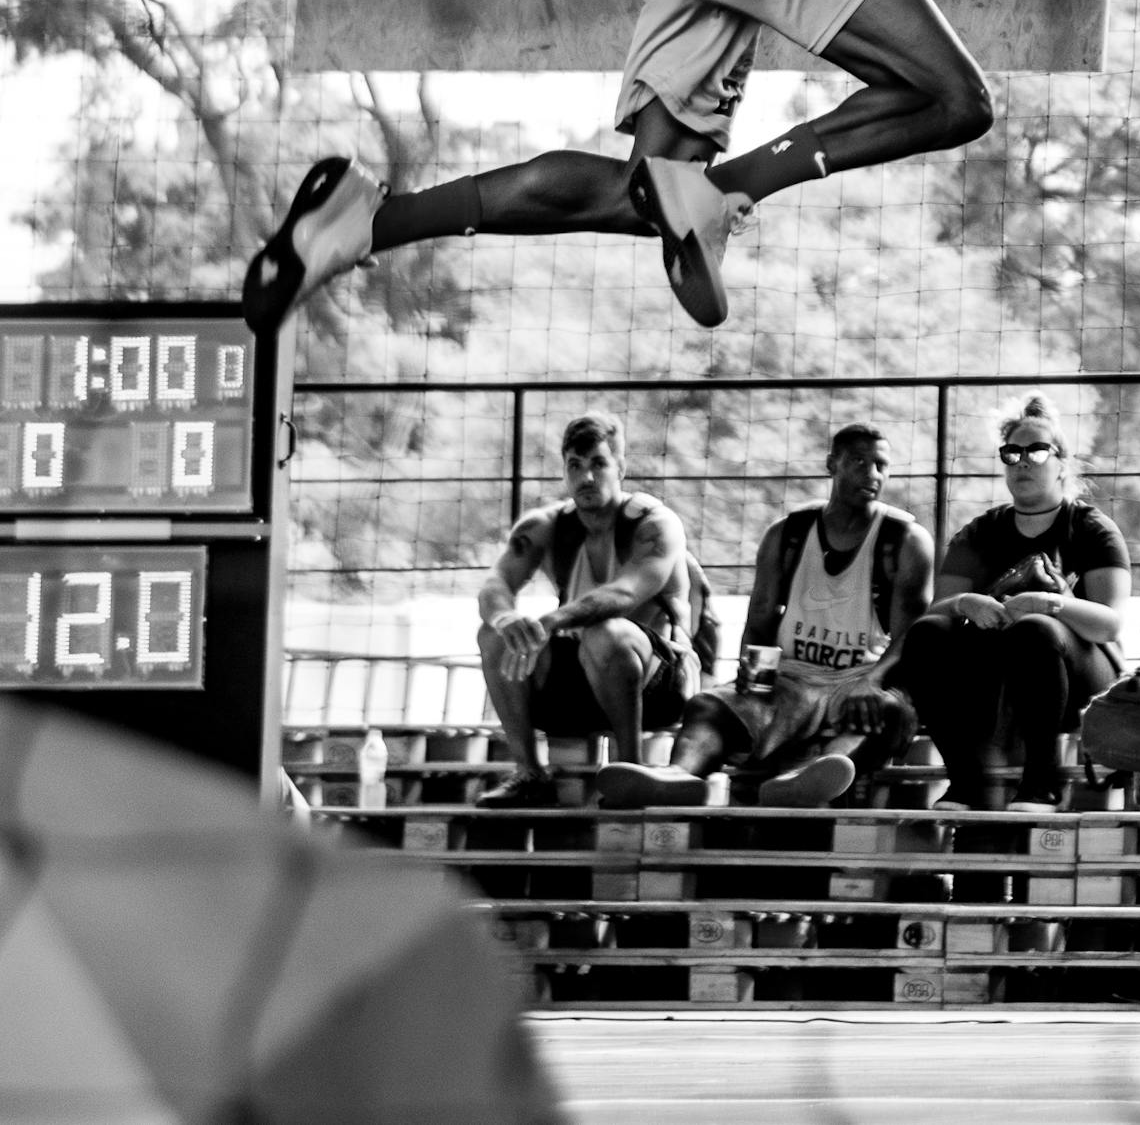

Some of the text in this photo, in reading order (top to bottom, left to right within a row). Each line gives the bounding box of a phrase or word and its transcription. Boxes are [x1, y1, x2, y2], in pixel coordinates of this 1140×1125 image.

[22, 421, 215, 488] 0 0
[24, 572, 192, 665] 12.0
[794, 620, 867, 647] BATTLE
[793, 638, 867, 671] FORCE
